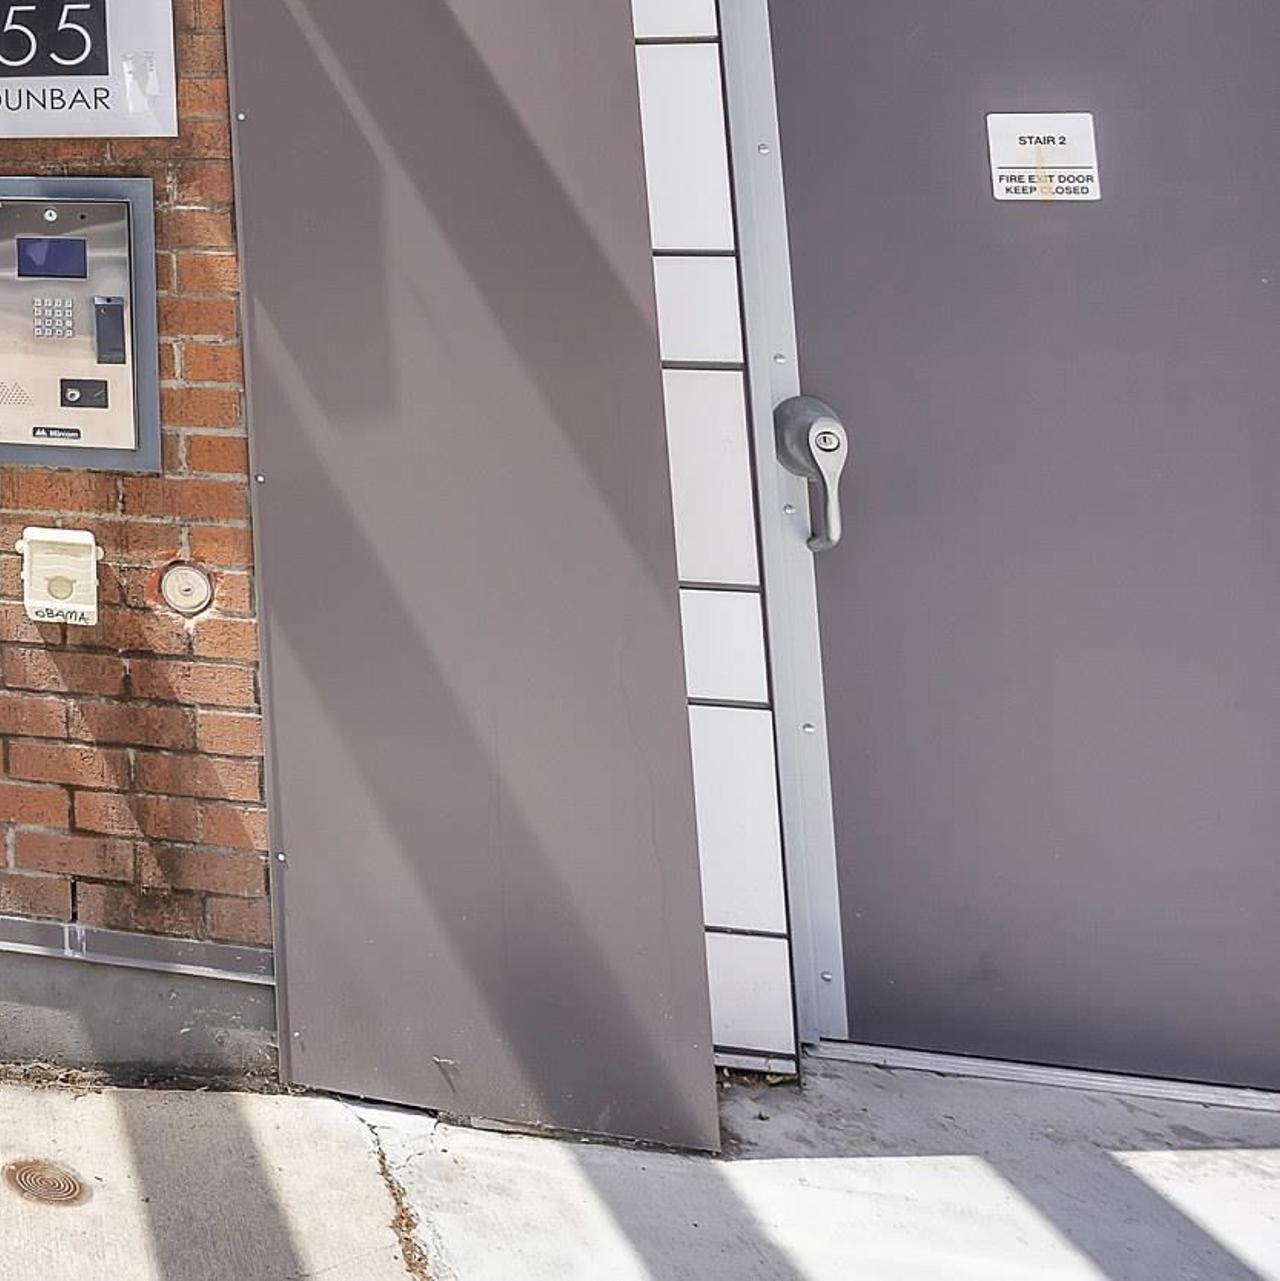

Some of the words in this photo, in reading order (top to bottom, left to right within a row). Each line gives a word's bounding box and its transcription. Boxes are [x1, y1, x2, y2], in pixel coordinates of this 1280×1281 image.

[1018, 135, 1056, 146] STAIR
[1058, 135, 1067, 146] 2
[998, 174, 1025, 184] FIRE
[1058, 174, 1094, 184] DOOR
[1005, 186, 1037, 195] KEEP
